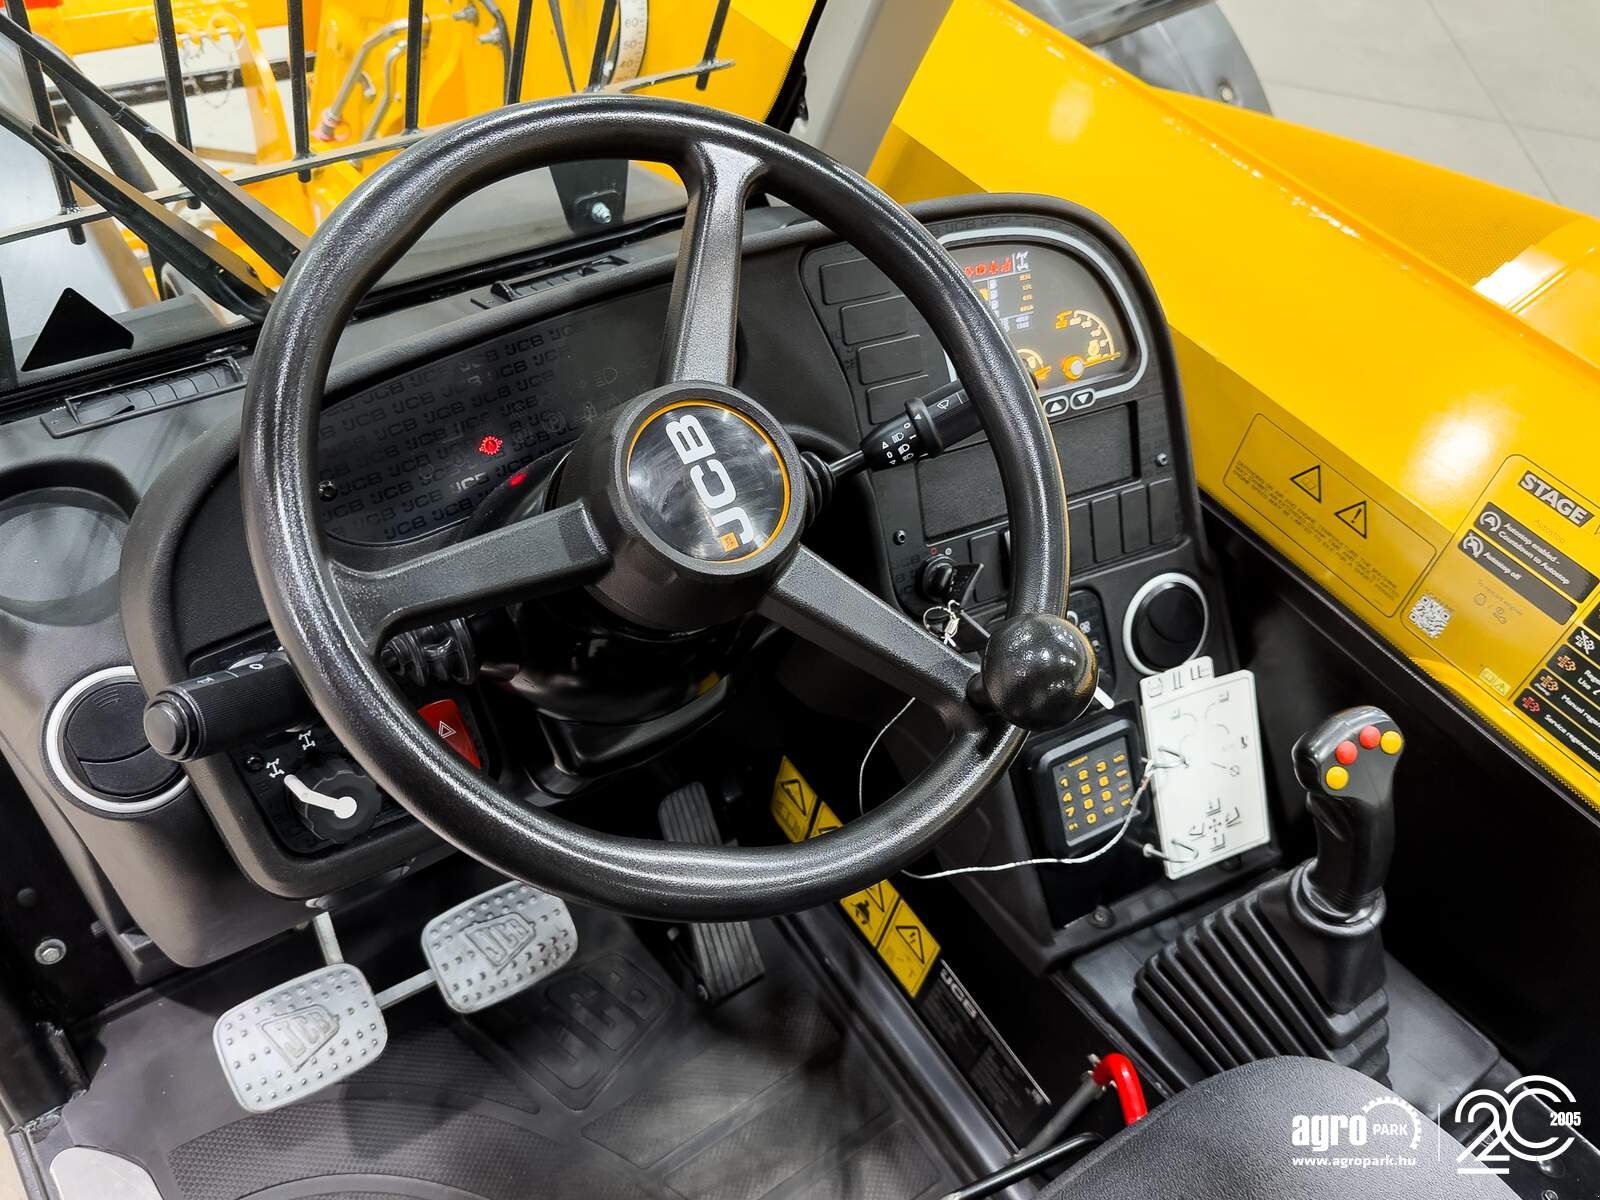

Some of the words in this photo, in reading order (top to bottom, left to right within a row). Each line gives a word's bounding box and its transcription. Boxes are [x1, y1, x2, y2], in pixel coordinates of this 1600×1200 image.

[375, 418, 417, 442] JCB
[423, 401, 465, 425] JCB
[471, 385, 512, 409] JCB
[392, 390, 435, 414] JCB
[405, 428, 448, 451] JCB
[337, 471, 383, 497] JCB
[389, 455, 431, 478] JCB
[455, 472, 490, 492] JCB
[665, 414, 754, 553] JCB
[369, 481, 414, 505] JCB
[1520, 473, 1588, 525] STAGE
[385, 516, 427, 540] JCB
[432, 497, 473, 522] JCB
[1503, 522, 1532, 545] Autostop
[1531, 542, 1558, 564] enabled
[1483, 551, 1511, 574] Autostop
[1510, 571, 1523, 581] off
[1498, 530, 1534, 559] Countdown
[1532, 556, 1541, 565] to
[1540, 562, 1570, 586] Autostop
[1577, 677, 1591, 690] Use
[1561, 694, 1585, 714] Manual
[1544, 714, 1567, 734] Service
[1060, 778, 1068, 788] 1
[1078, 769, 1089, 780] 2
[1096, 761, 1108, 772] 3
[1063, 792, 1072, 802] 4
[1065, 806, 1075, 817] 7
[1086, 813, 1097, 825] 0
[940, 967, 978, 1019] JCB
[281, 1010, 334, 1059] JCB
